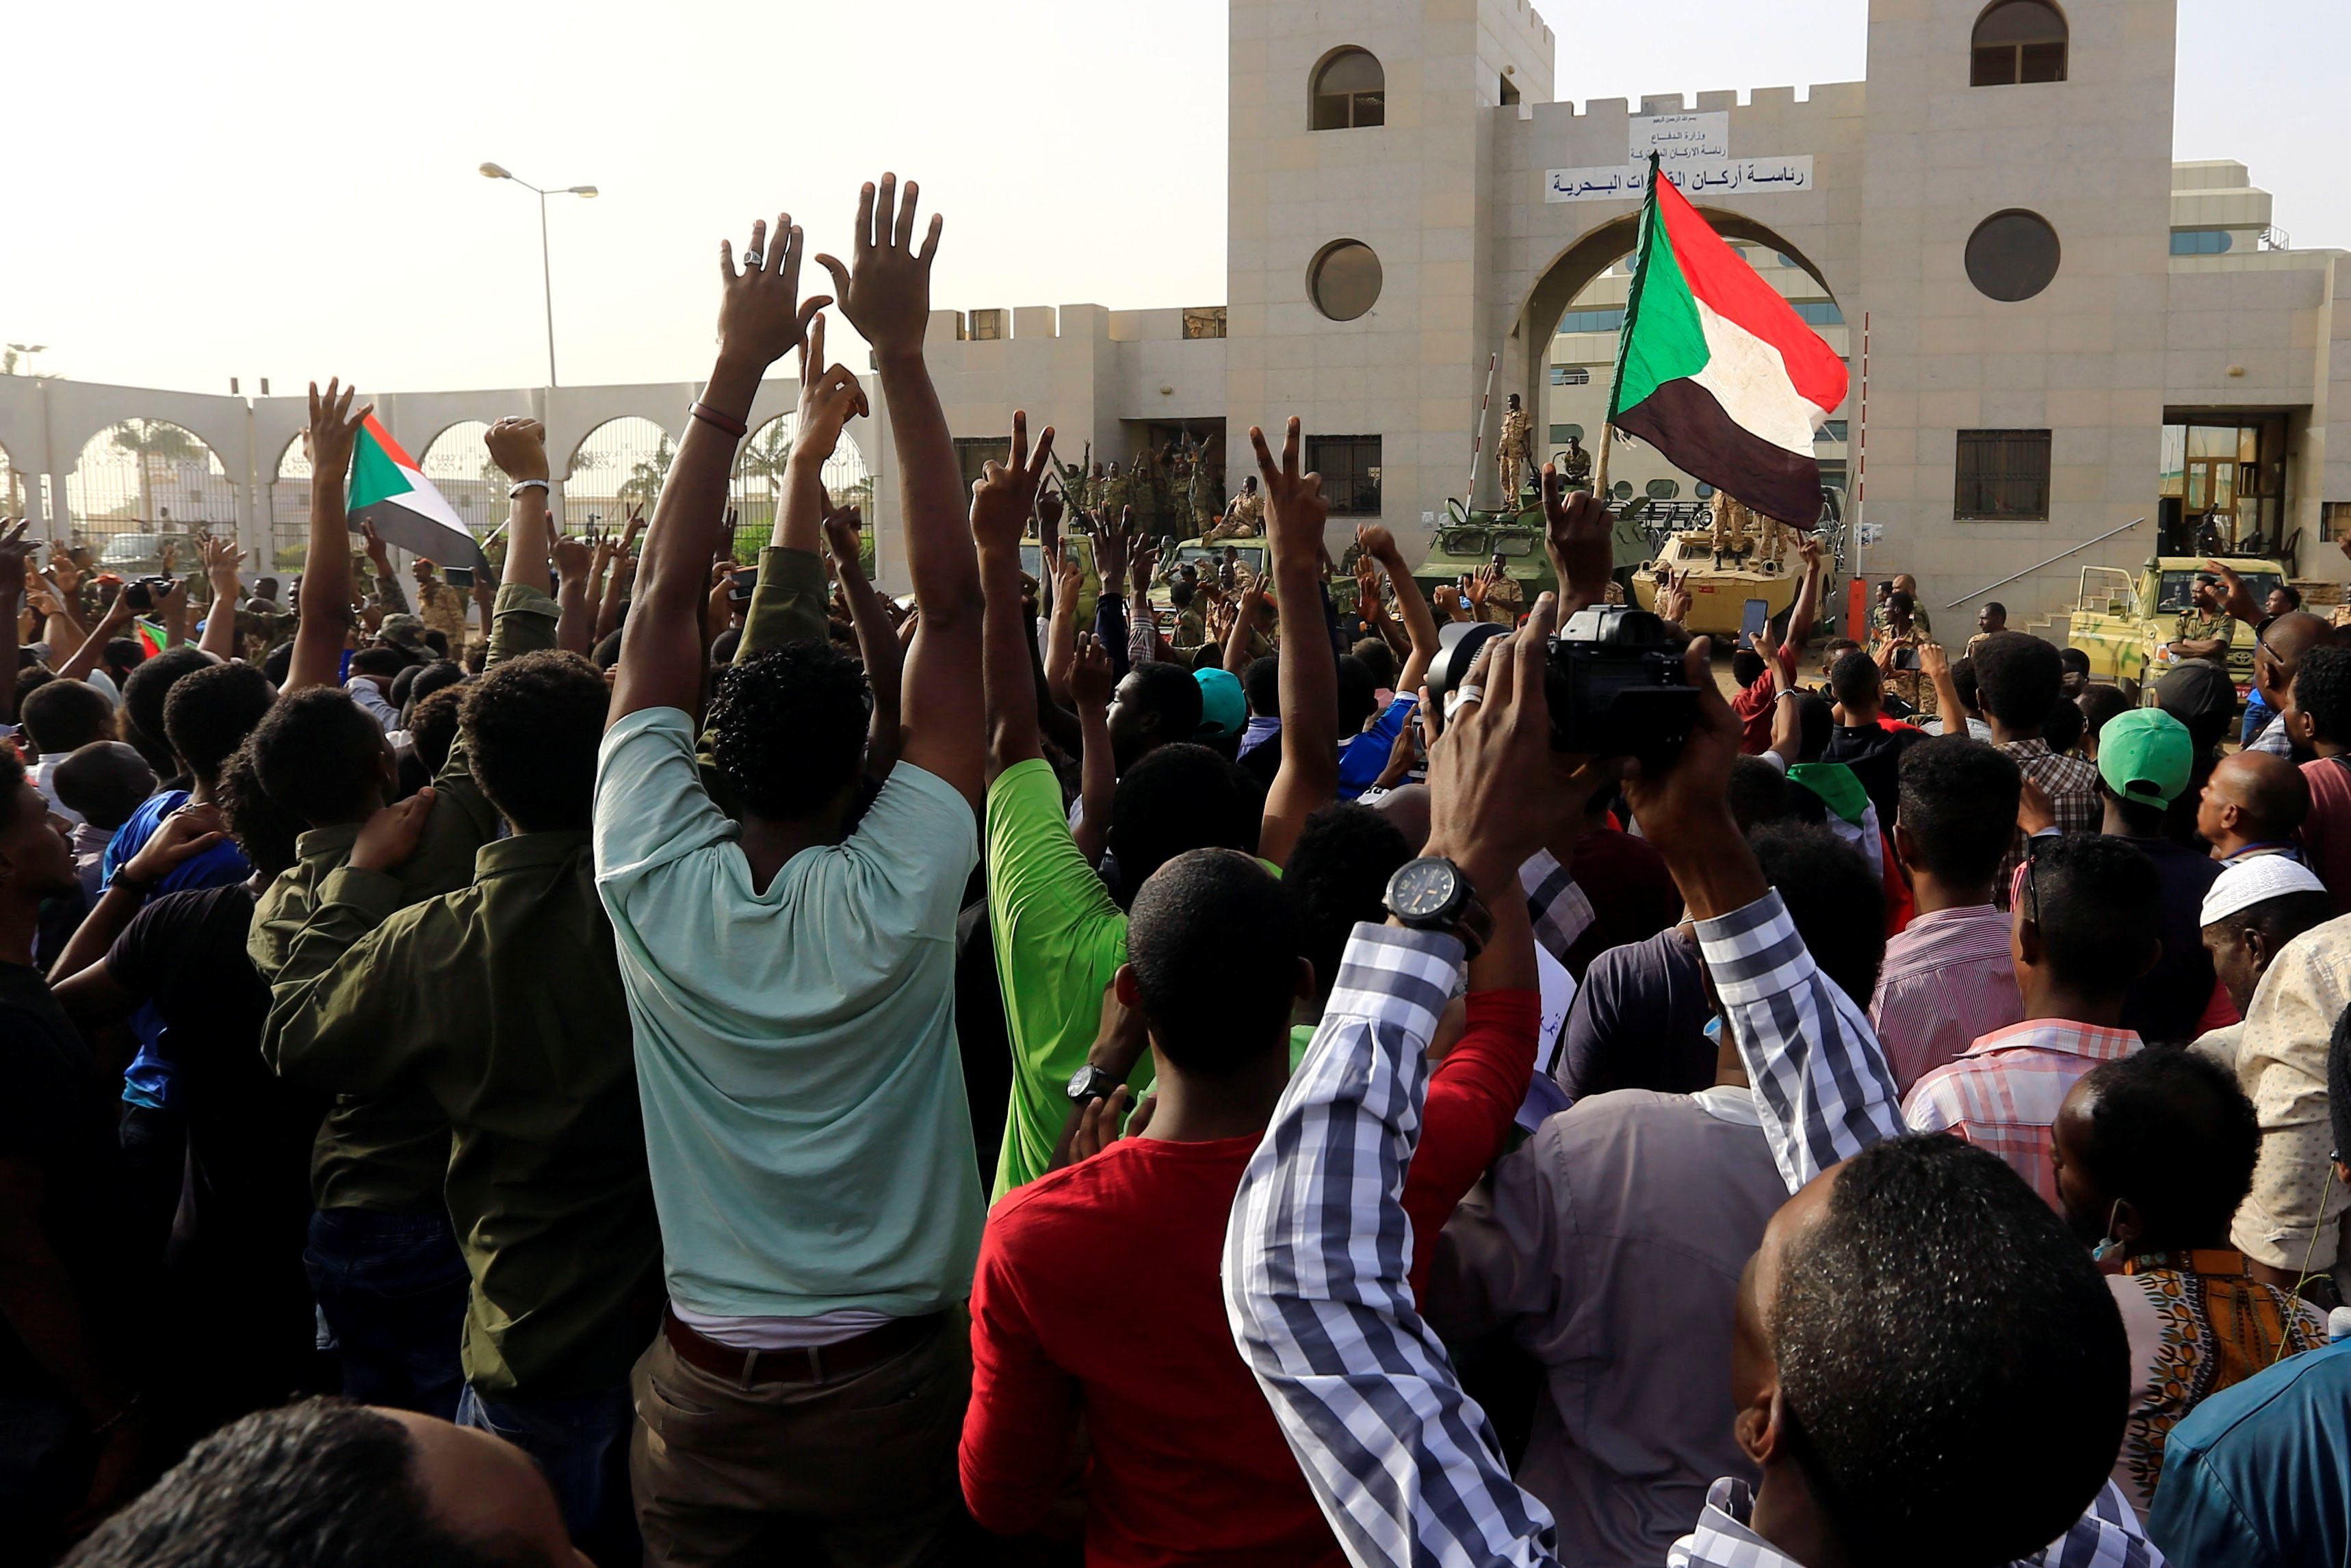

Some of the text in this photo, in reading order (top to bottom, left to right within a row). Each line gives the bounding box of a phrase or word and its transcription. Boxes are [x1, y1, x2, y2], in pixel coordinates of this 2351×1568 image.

[1651, 131, 1705, 144] وزارة الدفاع
[1553, 164, 1804, 196] رئاسة أركان القات البحرية
